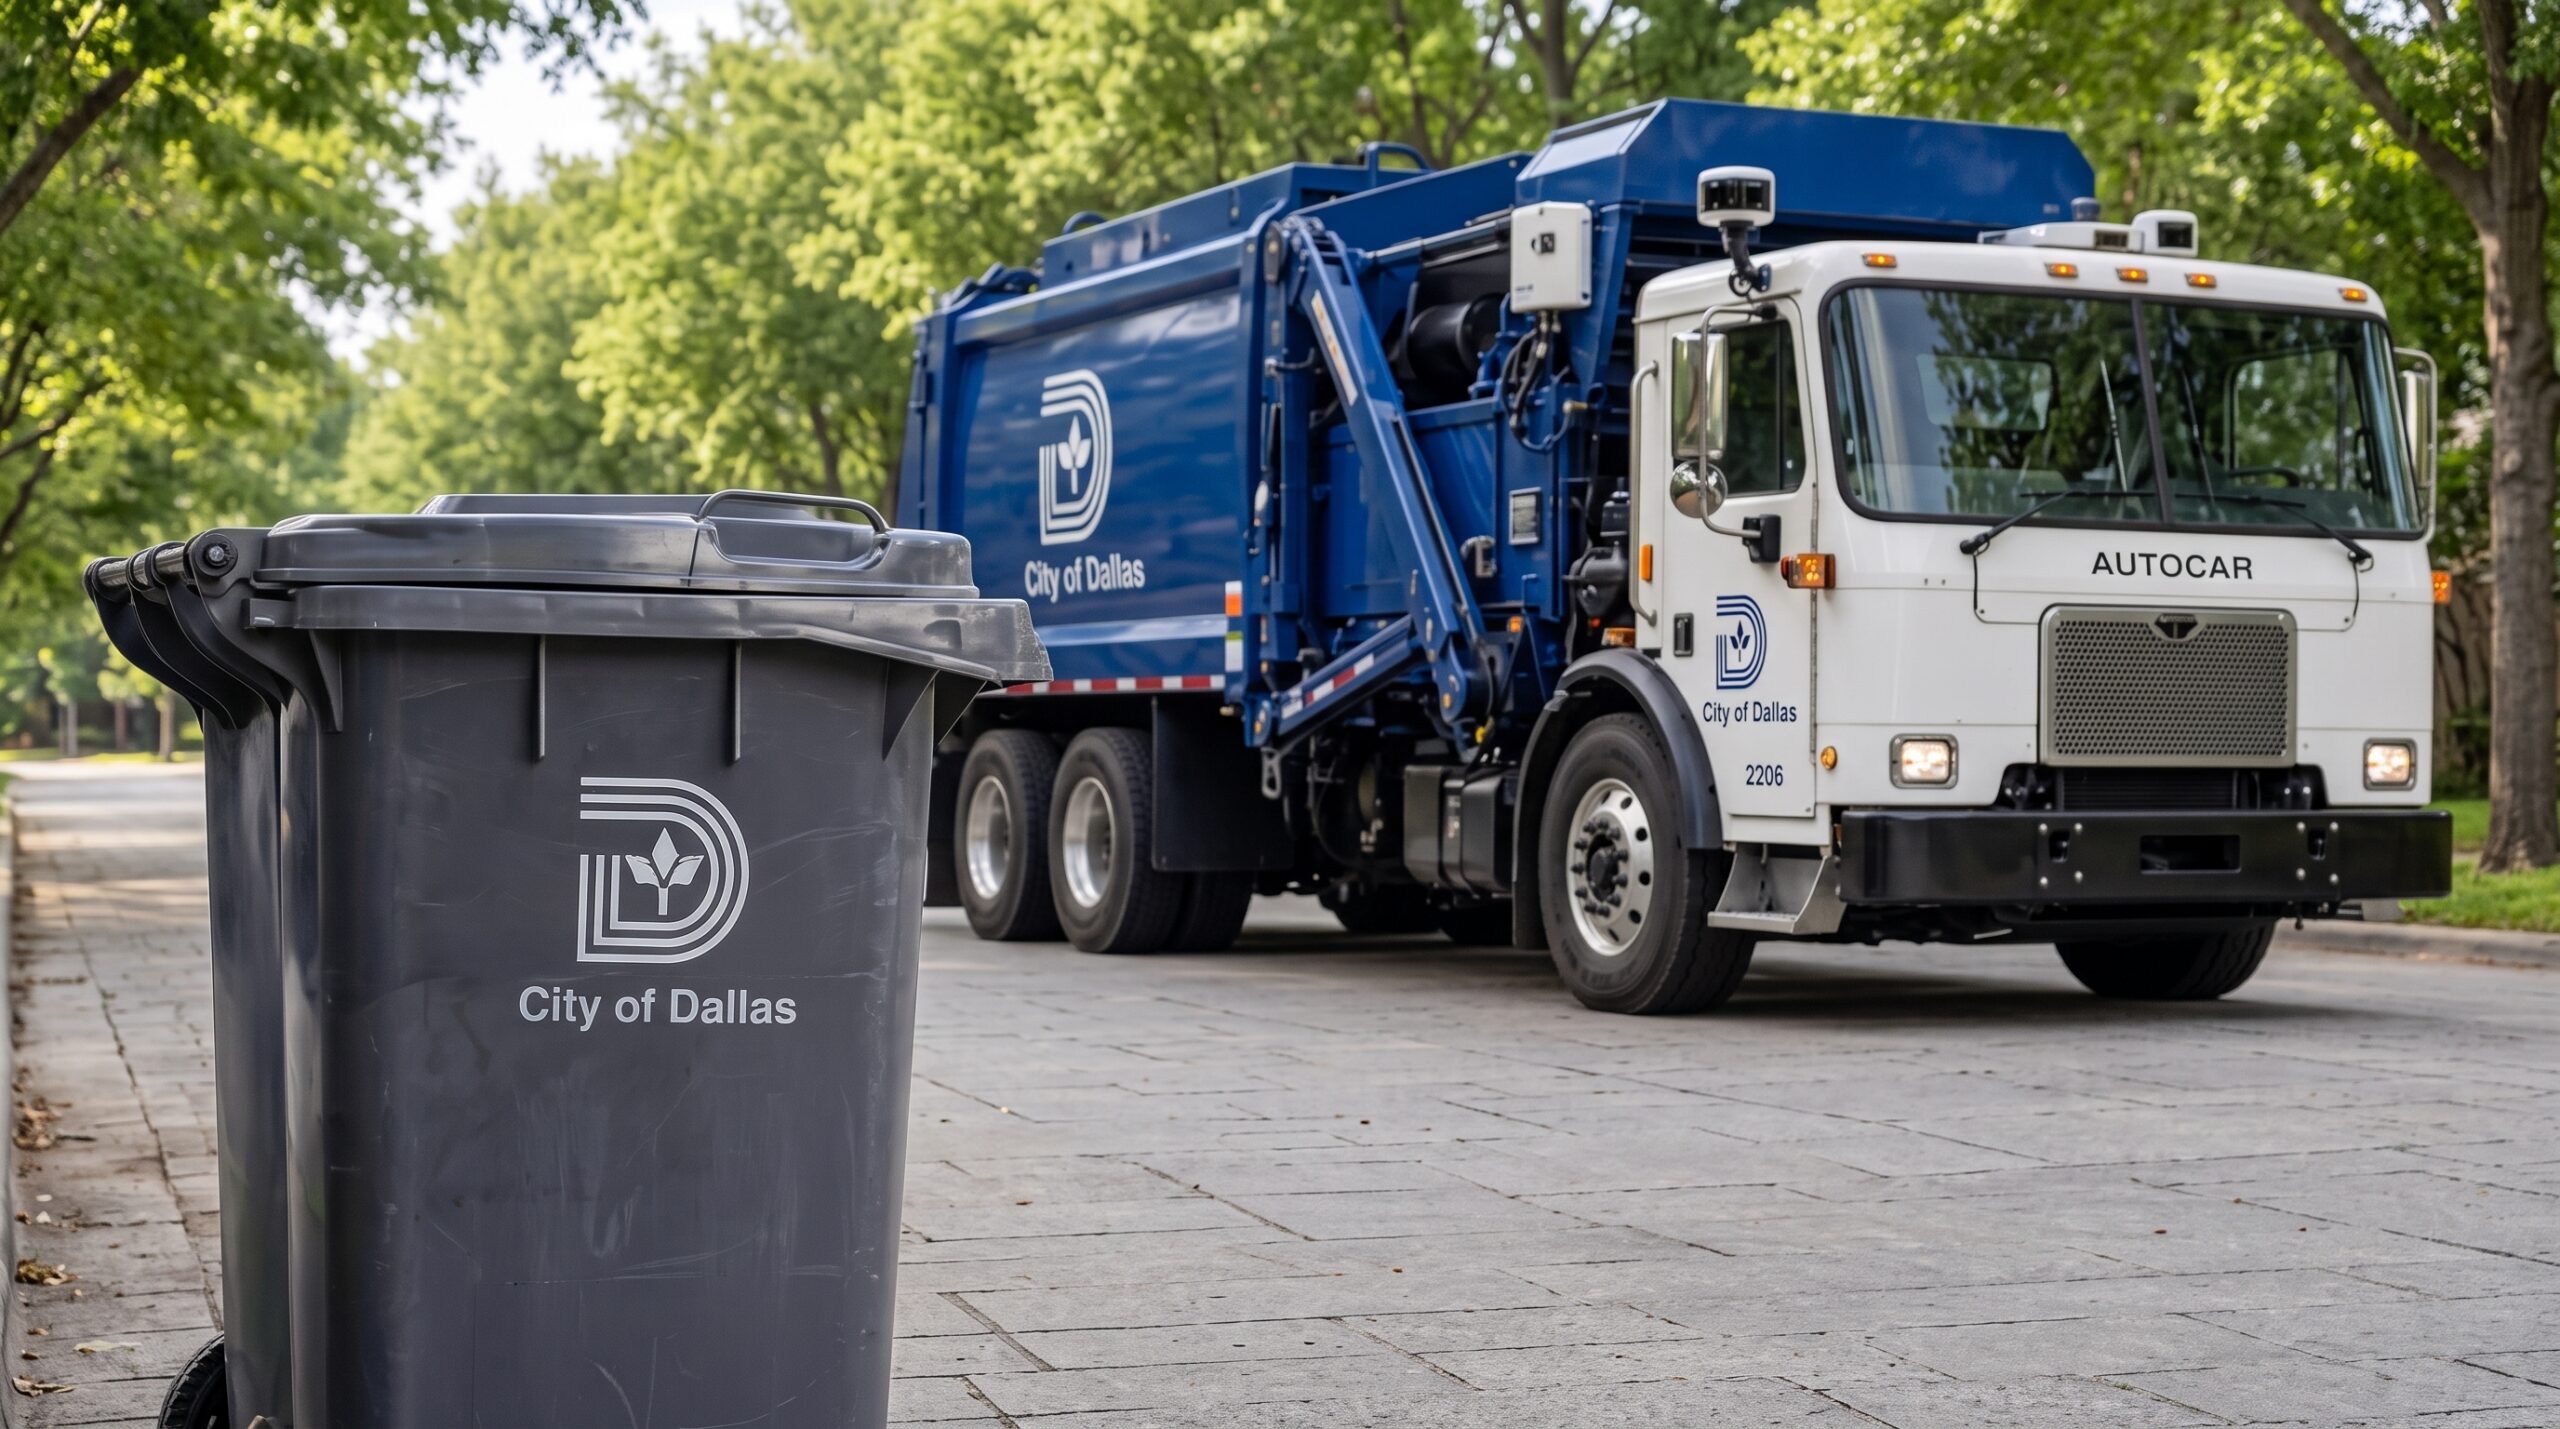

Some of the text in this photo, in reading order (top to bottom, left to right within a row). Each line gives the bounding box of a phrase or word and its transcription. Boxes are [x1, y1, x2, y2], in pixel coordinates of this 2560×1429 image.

[1024, 552, 1146, 603] City of Dallas
[2091, 551, 2253, 580] AUTOCAR
[1702, 700, 1797, 728] City of Dallas
[1745, 764, 1784, 787] 2206
[519, 985, 797, 1032] City of Dallas
